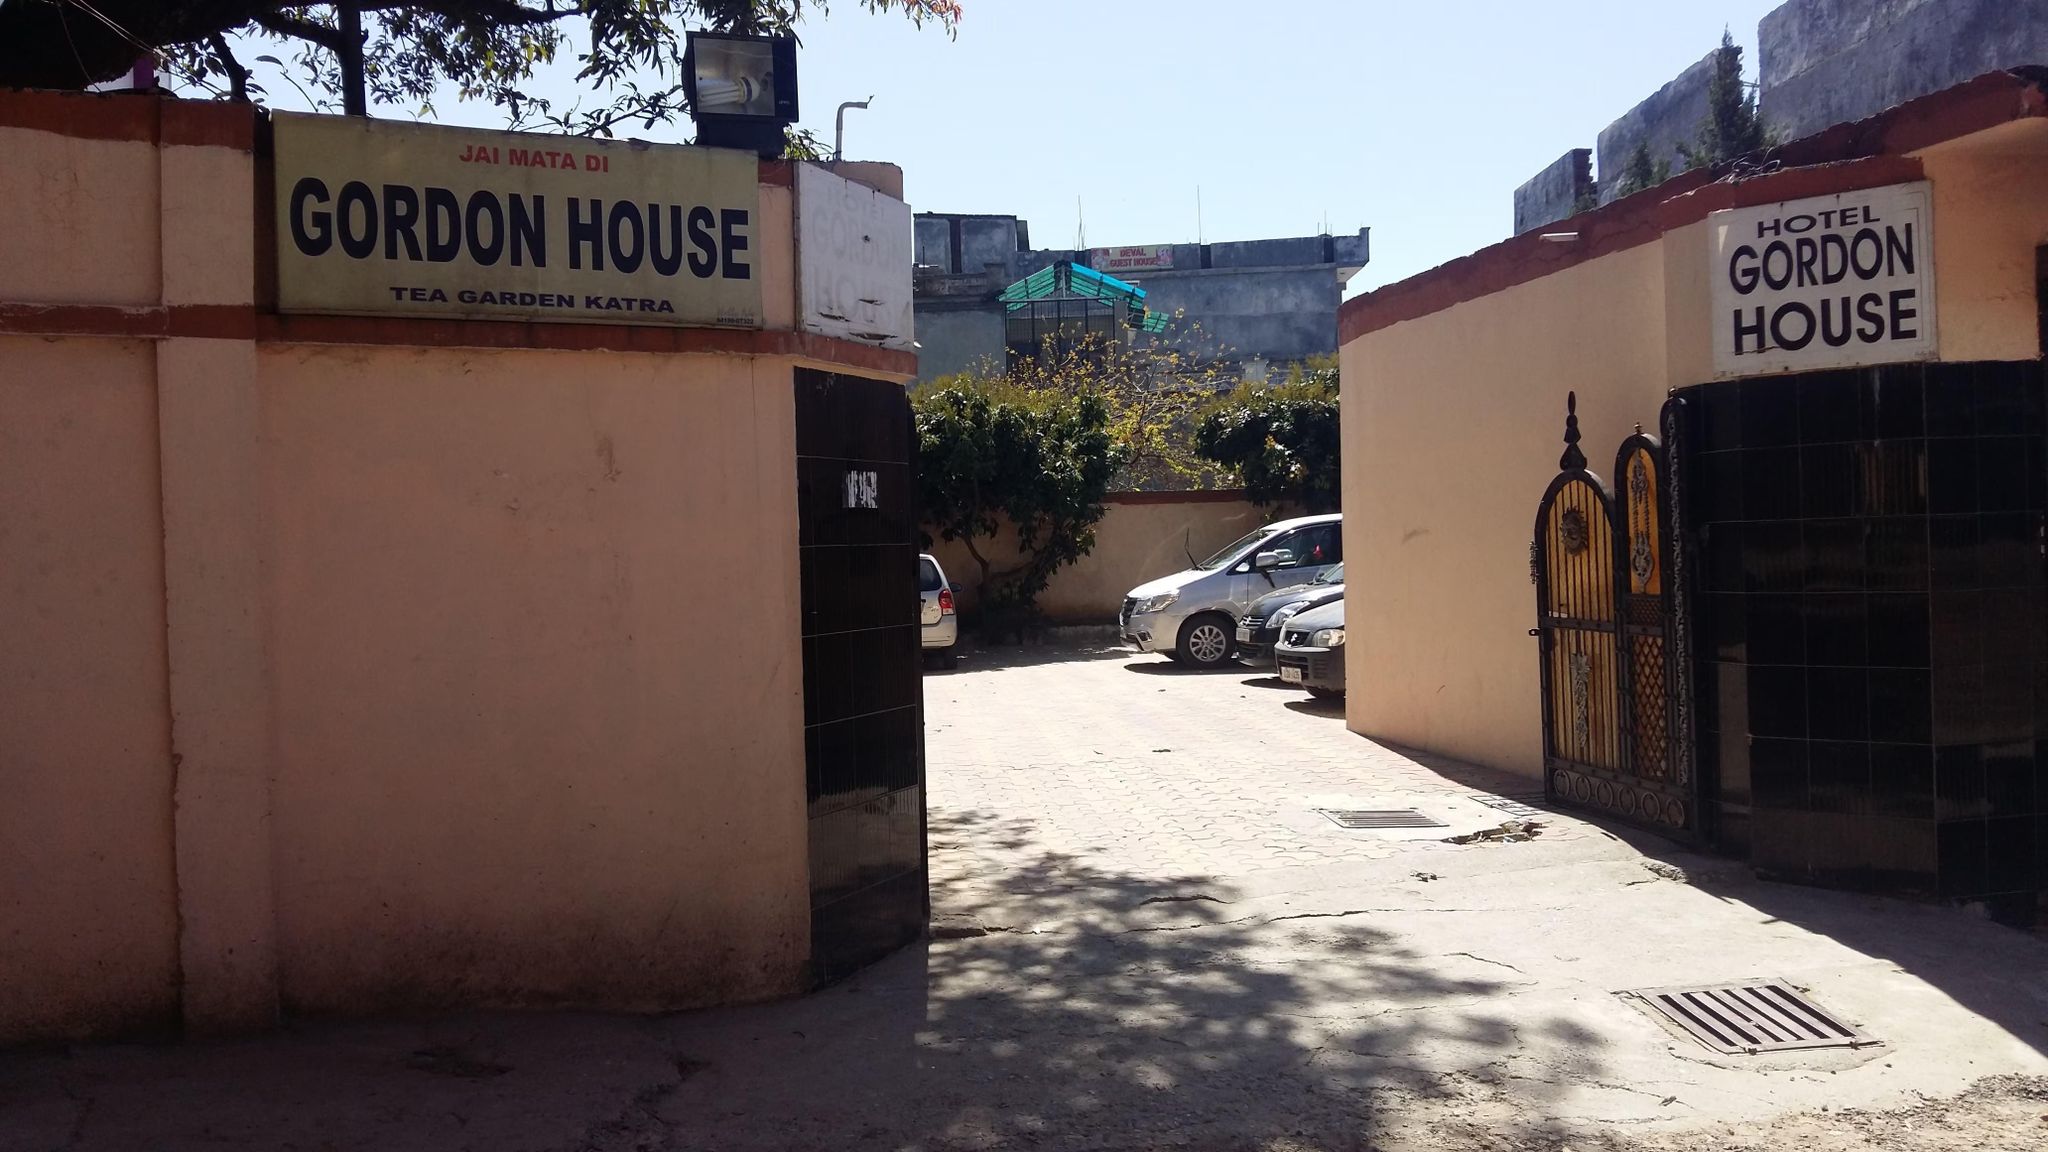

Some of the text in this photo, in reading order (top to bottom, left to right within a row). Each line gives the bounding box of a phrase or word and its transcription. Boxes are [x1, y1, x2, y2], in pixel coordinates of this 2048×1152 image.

[459, 144, 609, 173] JAI MATA DI
[289, 176, 751, 280] GORDON HOUSE
[1757, 205, 1881, 239] HOTEL
[1109, 258, 1132, 268] GUEST
[1729, 222, 1915, 295] GORDON
[389, 286, 675, 314] TEA GARDEN KATRA
[1733, 288, 1918, 356] HOUSE
